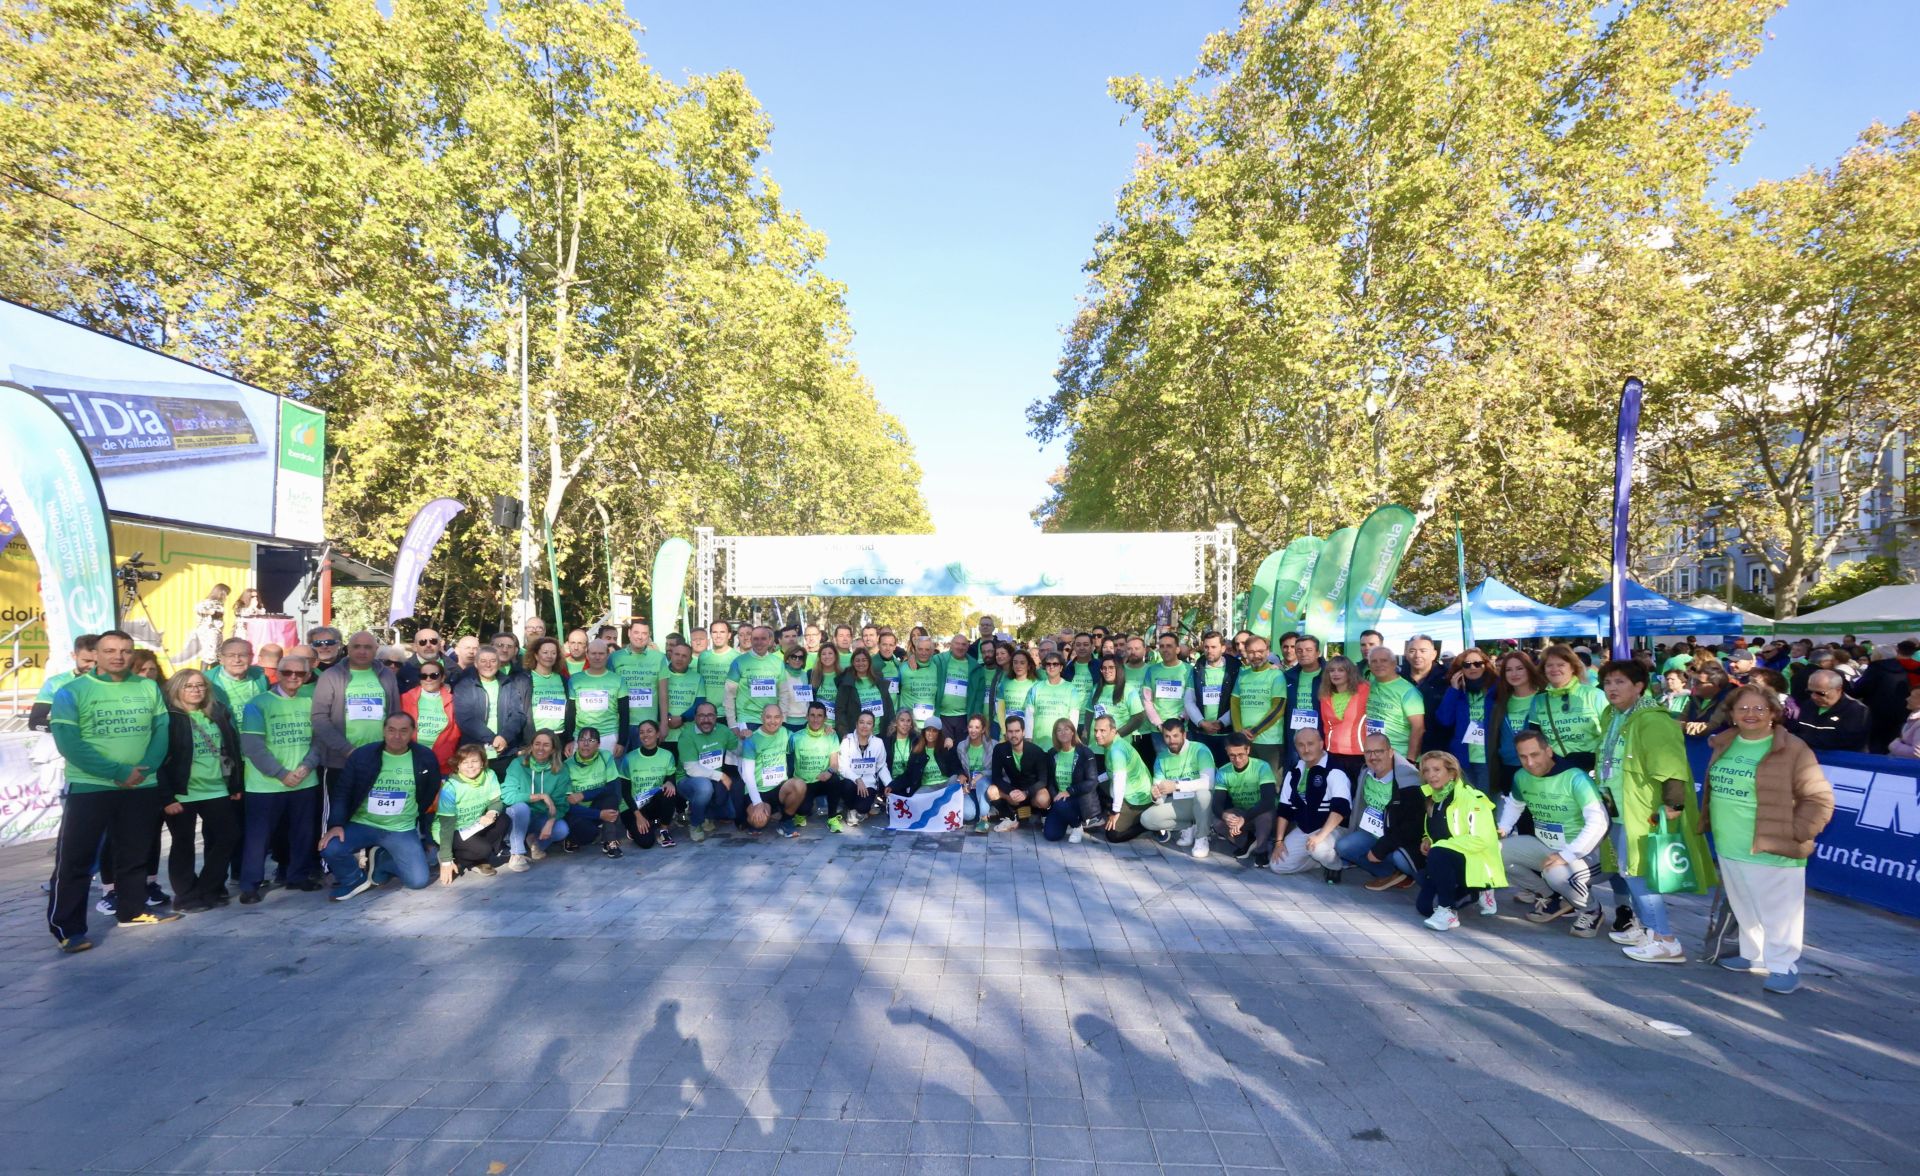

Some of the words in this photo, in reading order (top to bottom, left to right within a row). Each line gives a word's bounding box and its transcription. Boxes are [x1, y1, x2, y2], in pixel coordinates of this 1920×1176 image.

[102, 438, 117, 450] de
[118, 436, 171, 449] Valladolid
[1367, 523, 1404, 591] Iberdrola
[822, 576, 856, 586] contra
[858, 575, 869, 586] el
[97, 709, 112, 718] En
[97, 717, 137, 726] contra
[1535, 803, 1569, 812] marcha
[1539, 831, 1559, 841] 1634
